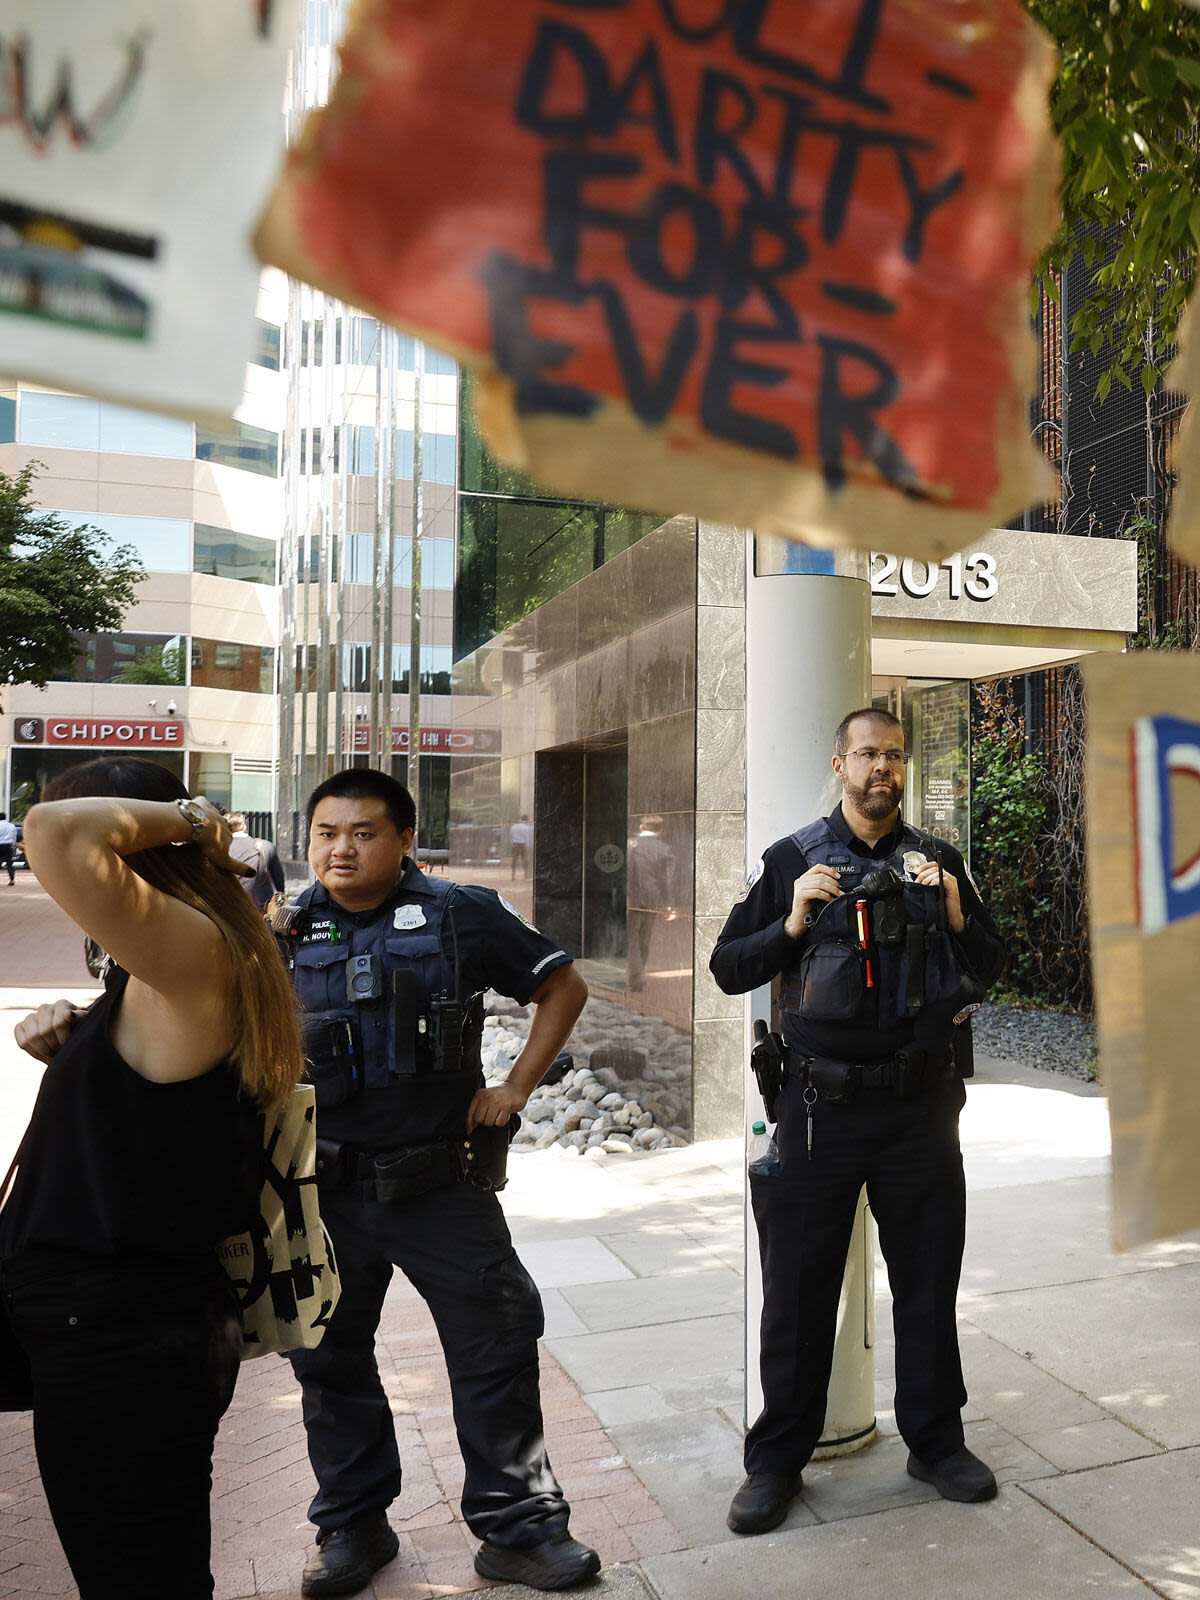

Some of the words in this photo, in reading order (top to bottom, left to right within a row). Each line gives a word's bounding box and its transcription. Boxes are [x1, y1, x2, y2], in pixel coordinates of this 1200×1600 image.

[514, 17, 966, 263] DARITY
[480, 250, 930, 498] EVER
[870, 550, 999, 601] 2013
[52, 723, 179, 741] CHIPOTLE
[311, 920, 331, 929] POLICE
[312, 931, 342, 940] NGUYN
